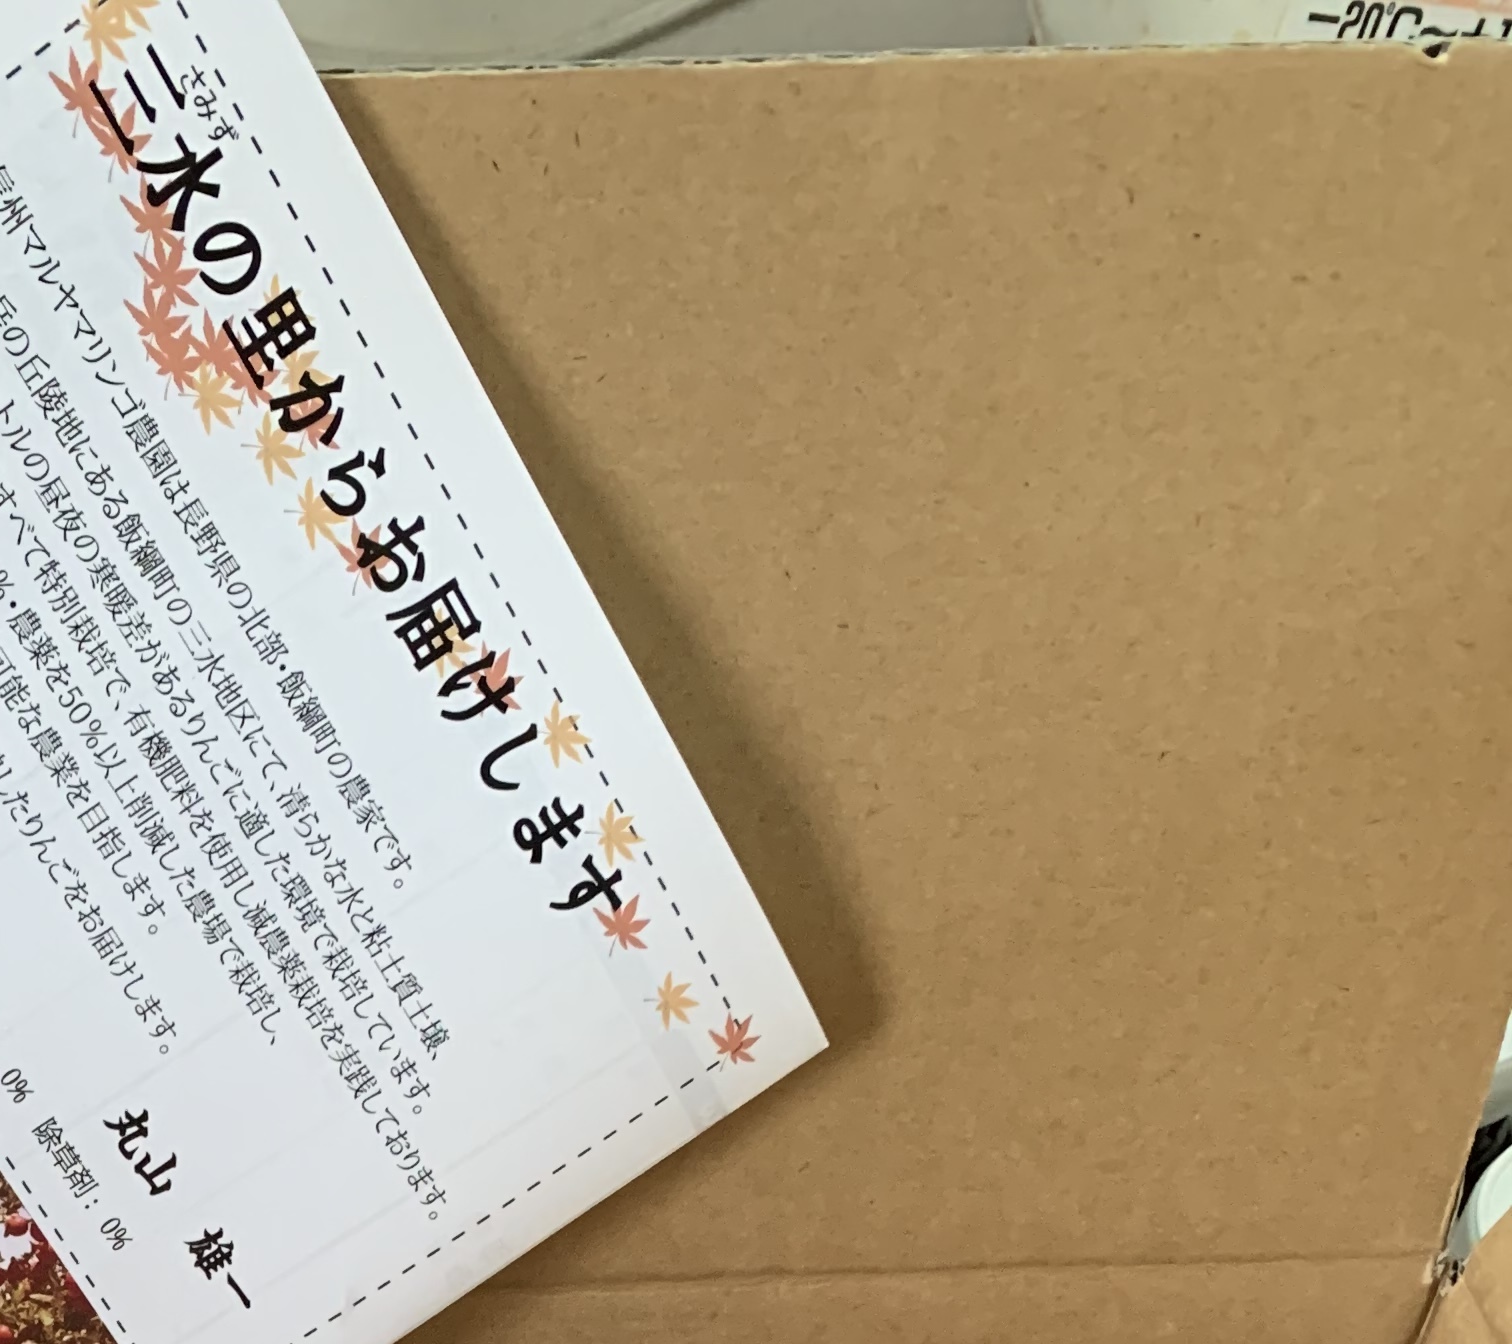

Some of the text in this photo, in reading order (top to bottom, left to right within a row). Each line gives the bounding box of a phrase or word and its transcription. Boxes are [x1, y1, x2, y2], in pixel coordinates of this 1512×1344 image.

[179, 64, 240, 141] さみず
[88, 44, 621, 911] 三水の里からお届けします
[0, 1068, 33, 1103] 0%
[100, 1217, 132, 1250] 0%
[102, 1109, 250, 1308] 丸山 雄一
